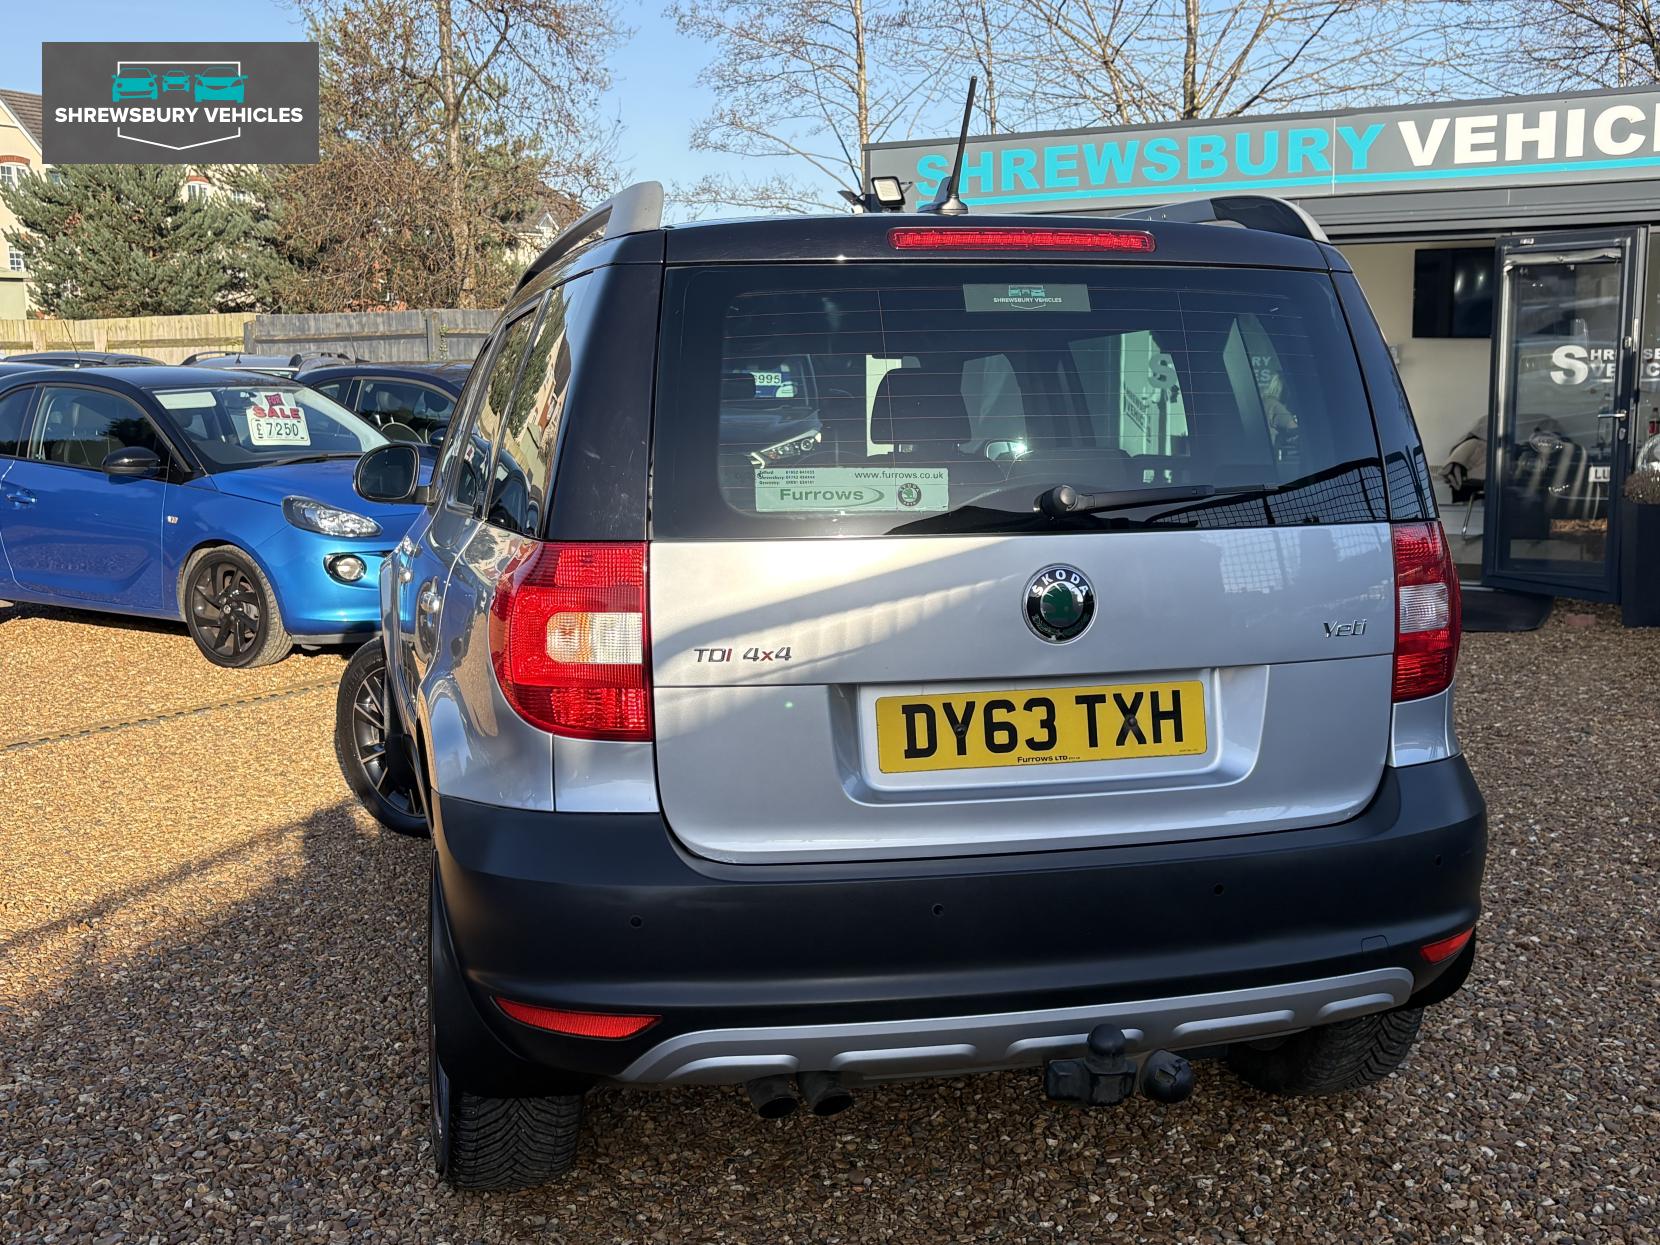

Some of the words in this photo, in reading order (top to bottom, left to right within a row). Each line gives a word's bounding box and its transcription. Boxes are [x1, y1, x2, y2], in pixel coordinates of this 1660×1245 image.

[914, 122, 1387, 197] SHREWSBURY
[1397, 102, 1660, 167] VEHIC
[252, 405, 302, 419] SALE
[854, 470, 944, 480] www.furrows.co.uk
[780, 489, 864, 501] Furrows
[1323, 618, 1367, 638] Yeti
[693, 648, 733, 662] TDI
[742, 646, 792, 662] 4x4
[902, 697, 1057, 759] DY63
[1075, 689, 1184, 748] TXH
